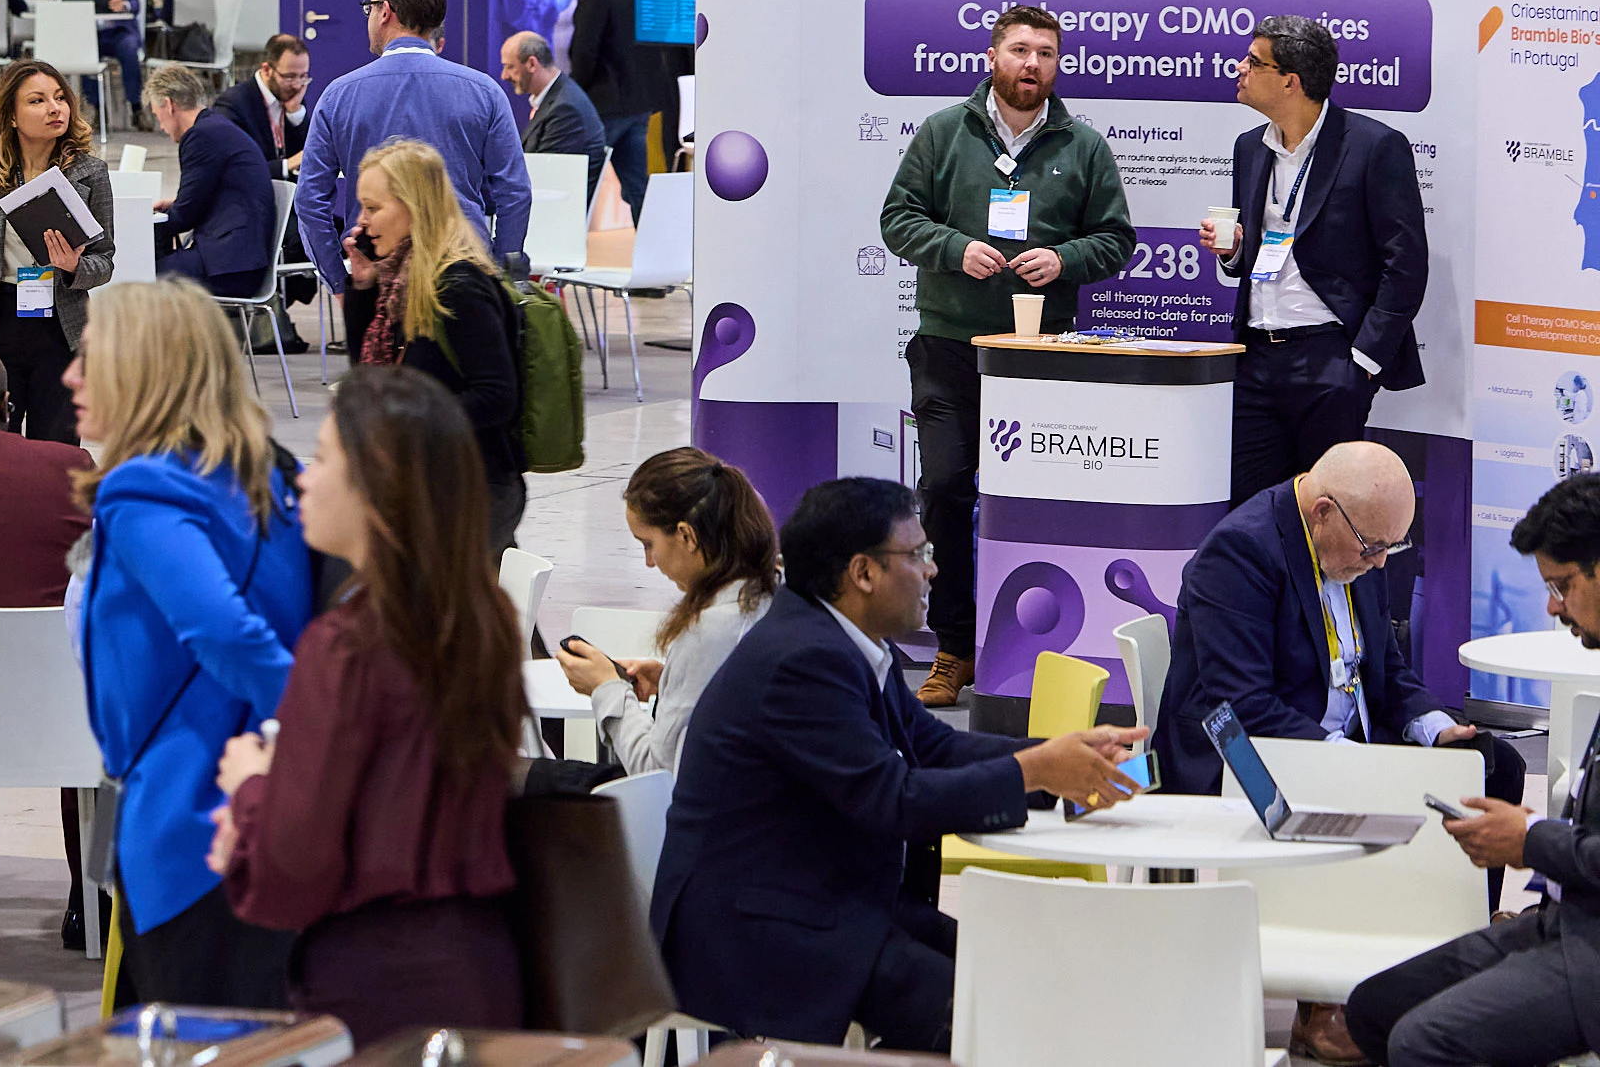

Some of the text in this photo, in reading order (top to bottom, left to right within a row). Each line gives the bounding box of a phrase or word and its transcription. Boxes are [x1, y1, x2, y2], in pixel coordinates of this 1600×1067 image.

[1040, 2, 1149, 42] erapy
[1159, 7, 1255, 36] CDMO
[1511, 26, 1568, 44] Bramble
[914, 43, 1400, 87] from elopment to ercial
[1511, 49, 1579, 71] in Portugal
[1106, 125, 1183, 144] Analytical
[1127, 153, 1155, 163] routine
[1157, 153, 1188, 165] analysis
[1190, 154, 1197, 163] to
[1524, 146, 1574, 161] BRAMBLE
[1117, 164, 1157, 175] imization,
[1424, 167, 1433, 177] for
[1123, 176, 1168, 186] QC release
[1092, 290, 1212, 308] cell therapy products
[1091, 307, 1141, 320] released
[1144, 309, 1188, 322] to-date
[1190, 310, 1206, 322] for
[1506, 313, 1521, 324] Cell
[1522, 314, 1554, 329] Therapy
[1555, 318, 1579, 329] CDMO
[1506, 327, 1524, 337] from
[1526, 329, 1577, 343] Development
[1579, 333, 1587, 343] to
[1492, 386, 1533, 398] Manufacturing
[1037, 423, 1067, 431] FAMICORD
[1031, 433, 1160, 459] BRAMBLE
[1499, 447, 1524, 460] Logistics
[1083, 459, 1103, 471] BIO
